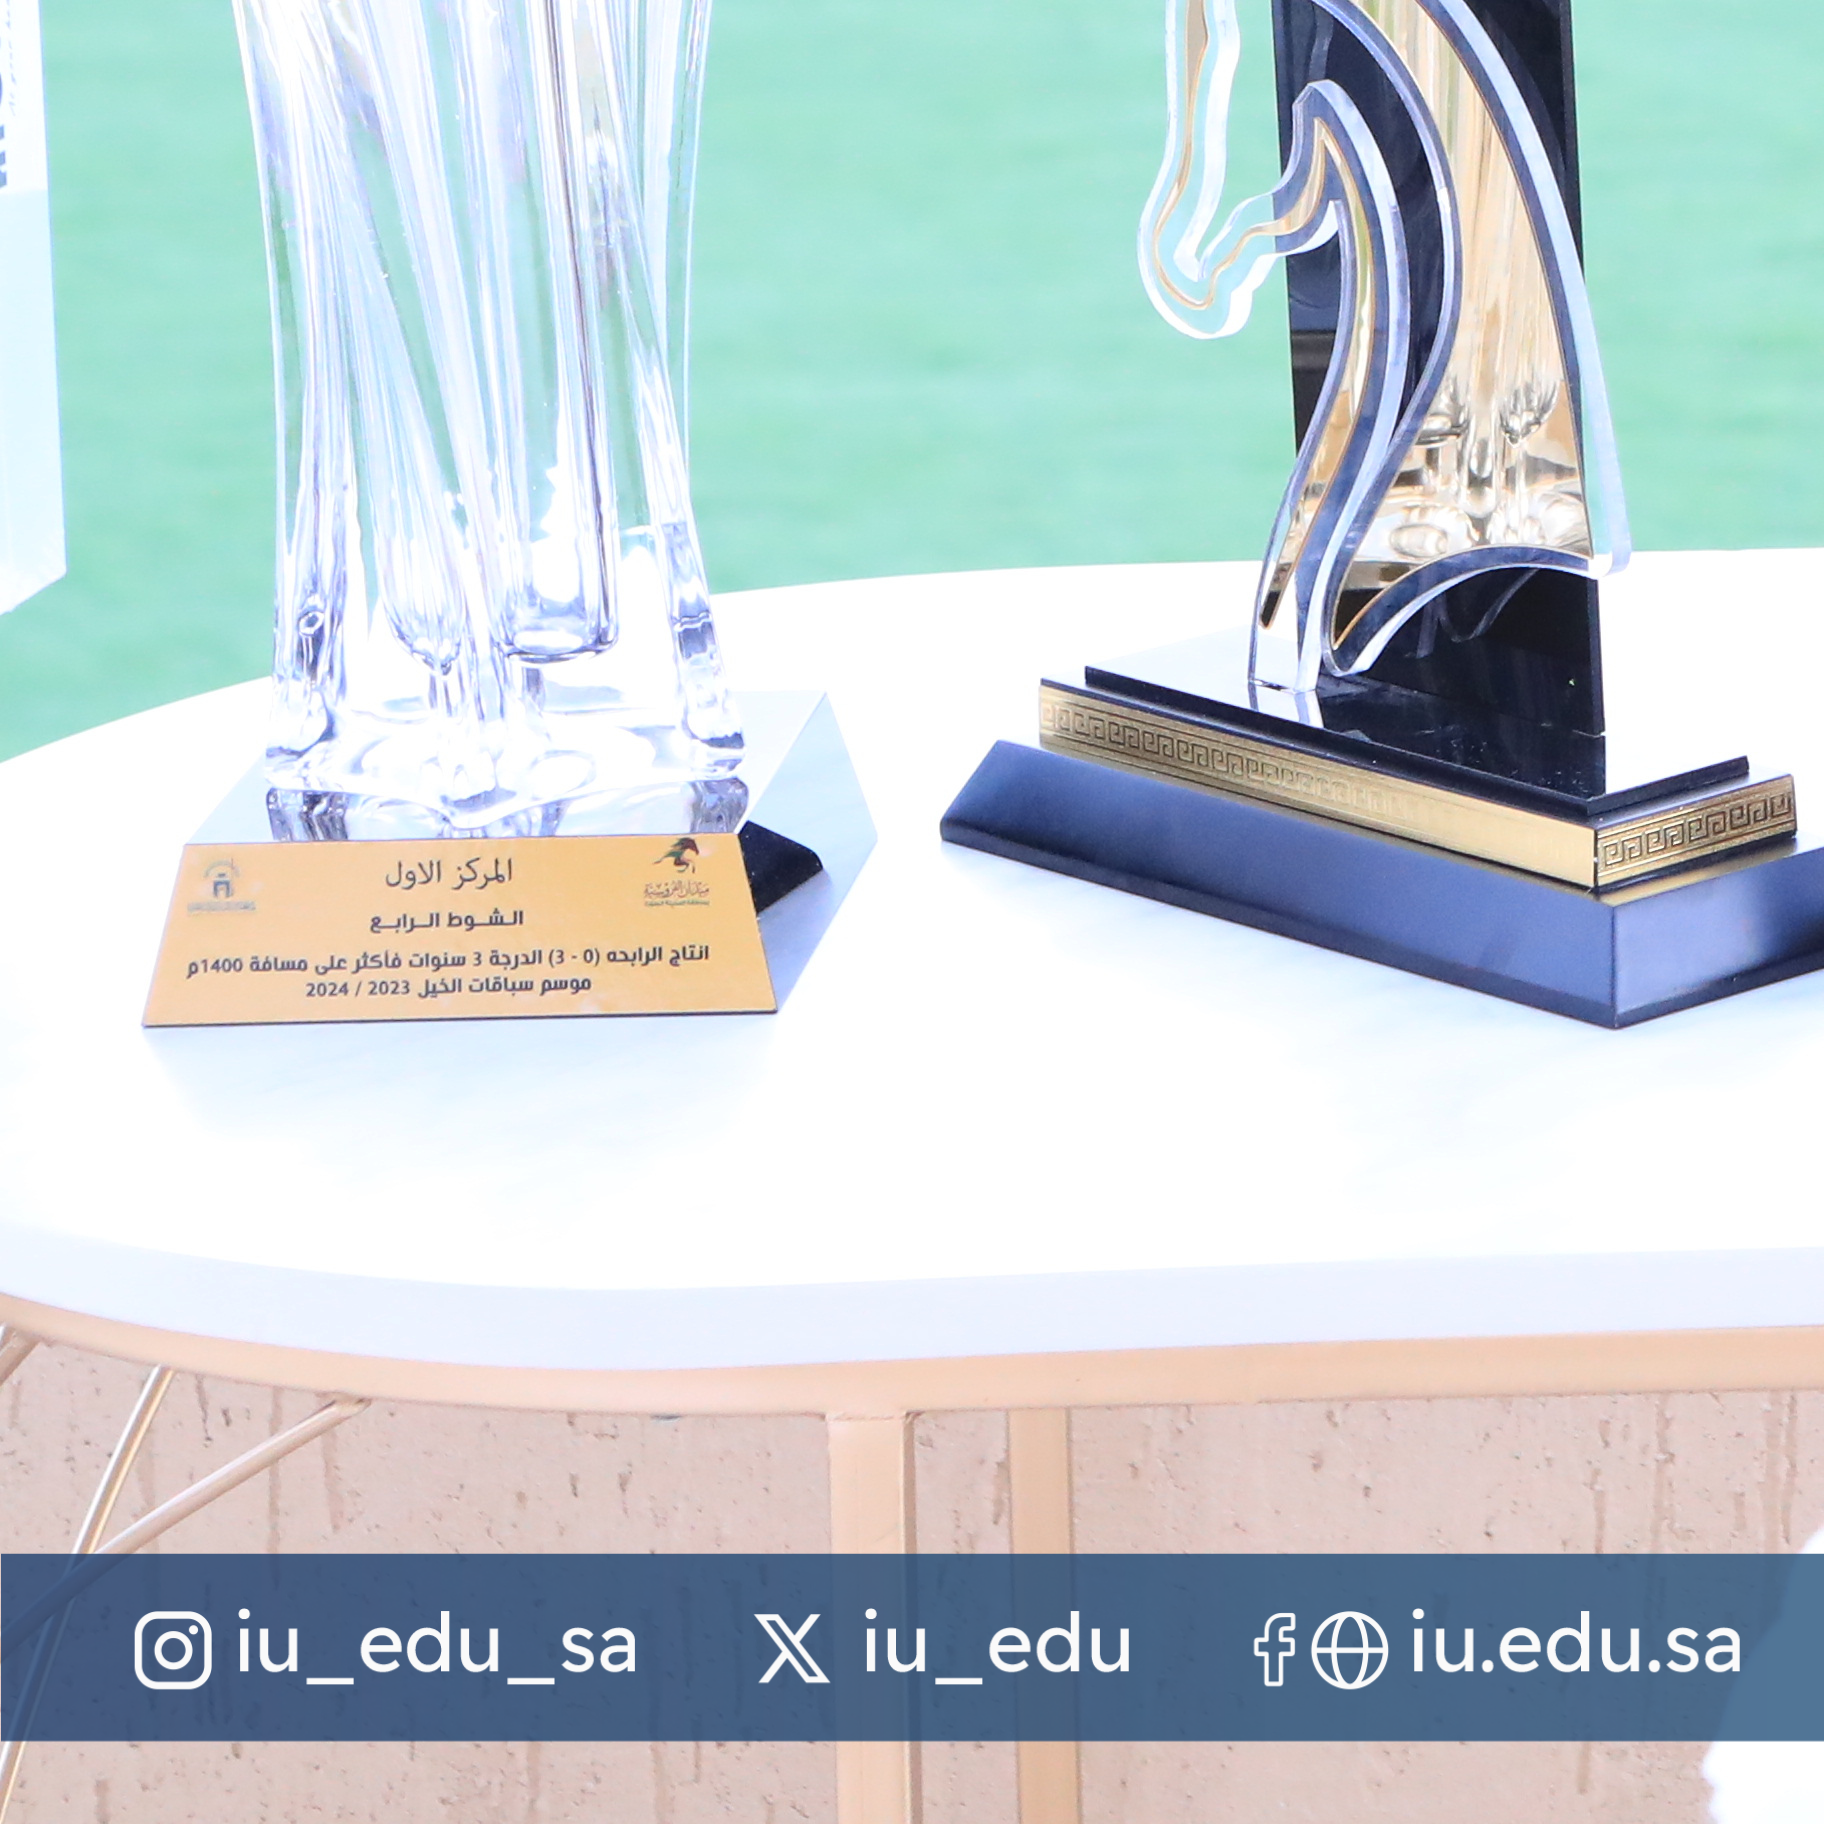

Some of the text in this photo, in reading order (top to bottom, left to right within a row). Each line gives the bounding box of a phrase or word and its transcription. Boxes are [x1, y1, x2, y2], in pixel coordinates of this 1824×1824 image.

[385, 857, 512, 891] المركز الاول
[370, 907, 524, 934] الشوط الرابع
[249, 955, 308, 972] مسافة
[314, 954, 348, 975] على
[350, 949, 402, 974] فأكثر
[408, 950, 466, 972] سنوات
[472, 952, 482, 967] 3
[489, 949, 543, 970] الدرجة
[607, 945, 663, 967] الرابحه
[669, 945, 709, 967] انتاج
[306, 982, 349, 997] 2024
[368, 980, 410, 996] 2023
[417, 977, 462, 998] الخيل
[468, 976, 534, 996] سباقات
[540, 977, 592, 996] موسم
